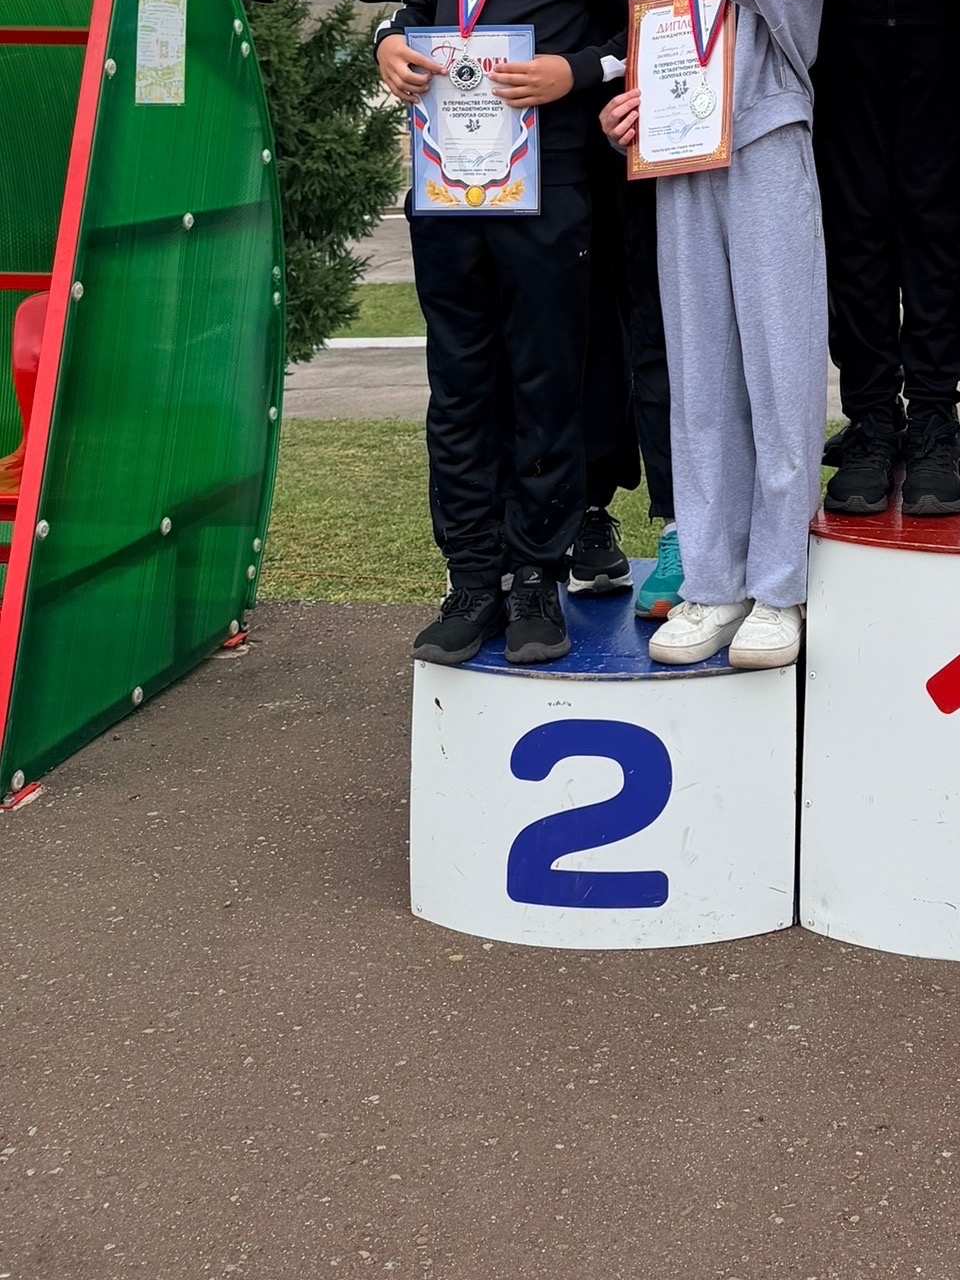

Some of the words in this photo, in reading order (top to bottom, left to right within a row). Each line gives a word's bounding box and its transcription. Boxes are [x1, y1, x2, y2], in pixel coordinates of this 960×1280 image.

[656, 19, 692, 34] ДИПЛ
[652, 32, 687, 40] НАГРАЖДАЕТСЯ
[658, 60, 686, 68] ПЕРВЕНСТВЕ
[461, 67, 471, 80] 2
[661, 66, 694, 74] ЭСТАФЕТНОМУ
[507, 720, 672, 909] 2
